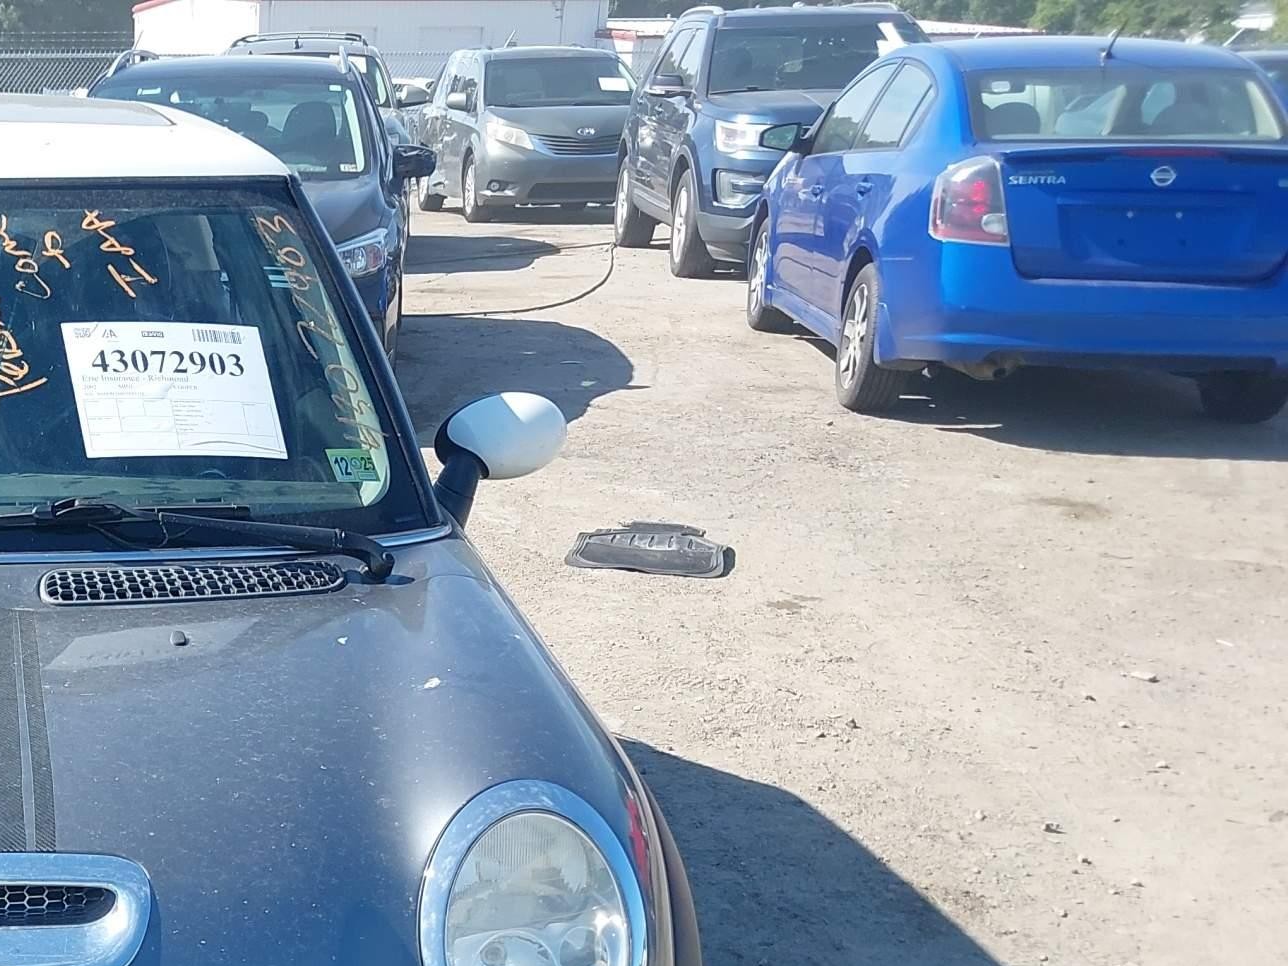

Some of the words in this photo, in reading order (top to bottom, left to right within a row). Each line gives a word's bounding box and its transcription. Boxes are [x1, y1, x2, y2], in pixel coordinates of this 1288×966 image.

[1007, 175, 1066, 185] SENTRA
[91, 349, 245, 377] 43072903
[333, 456, 353, 476] 12
[359, 456, 375, 471] 25
